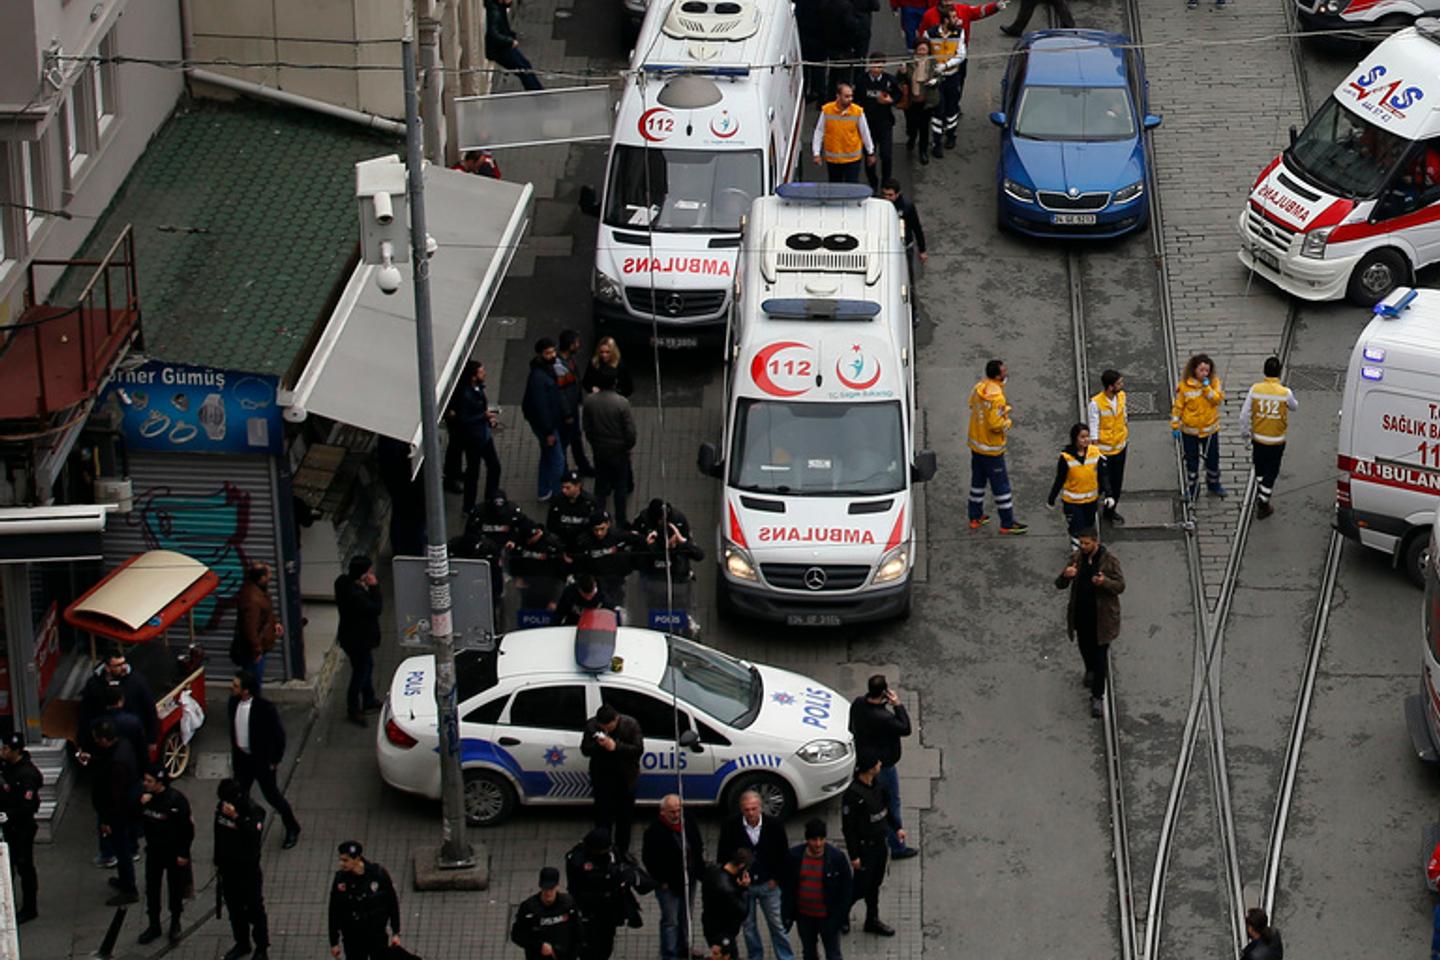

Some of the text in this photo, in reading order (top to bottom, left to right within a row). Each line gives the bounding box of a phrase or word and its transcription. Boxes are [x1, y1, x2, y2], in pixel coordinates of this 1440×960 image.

[648, 118, 675, 132] 112
[110, 367, 226, 391] orner Gümüş
[769, 360, 812, 376] 112
[1257, 399, 1279, 415] 112
[1382, 413, 1426, 437] SAĞLIK
[800, 687, 832, 730] POLİS
[642, 747, 688, 770] OLİS
